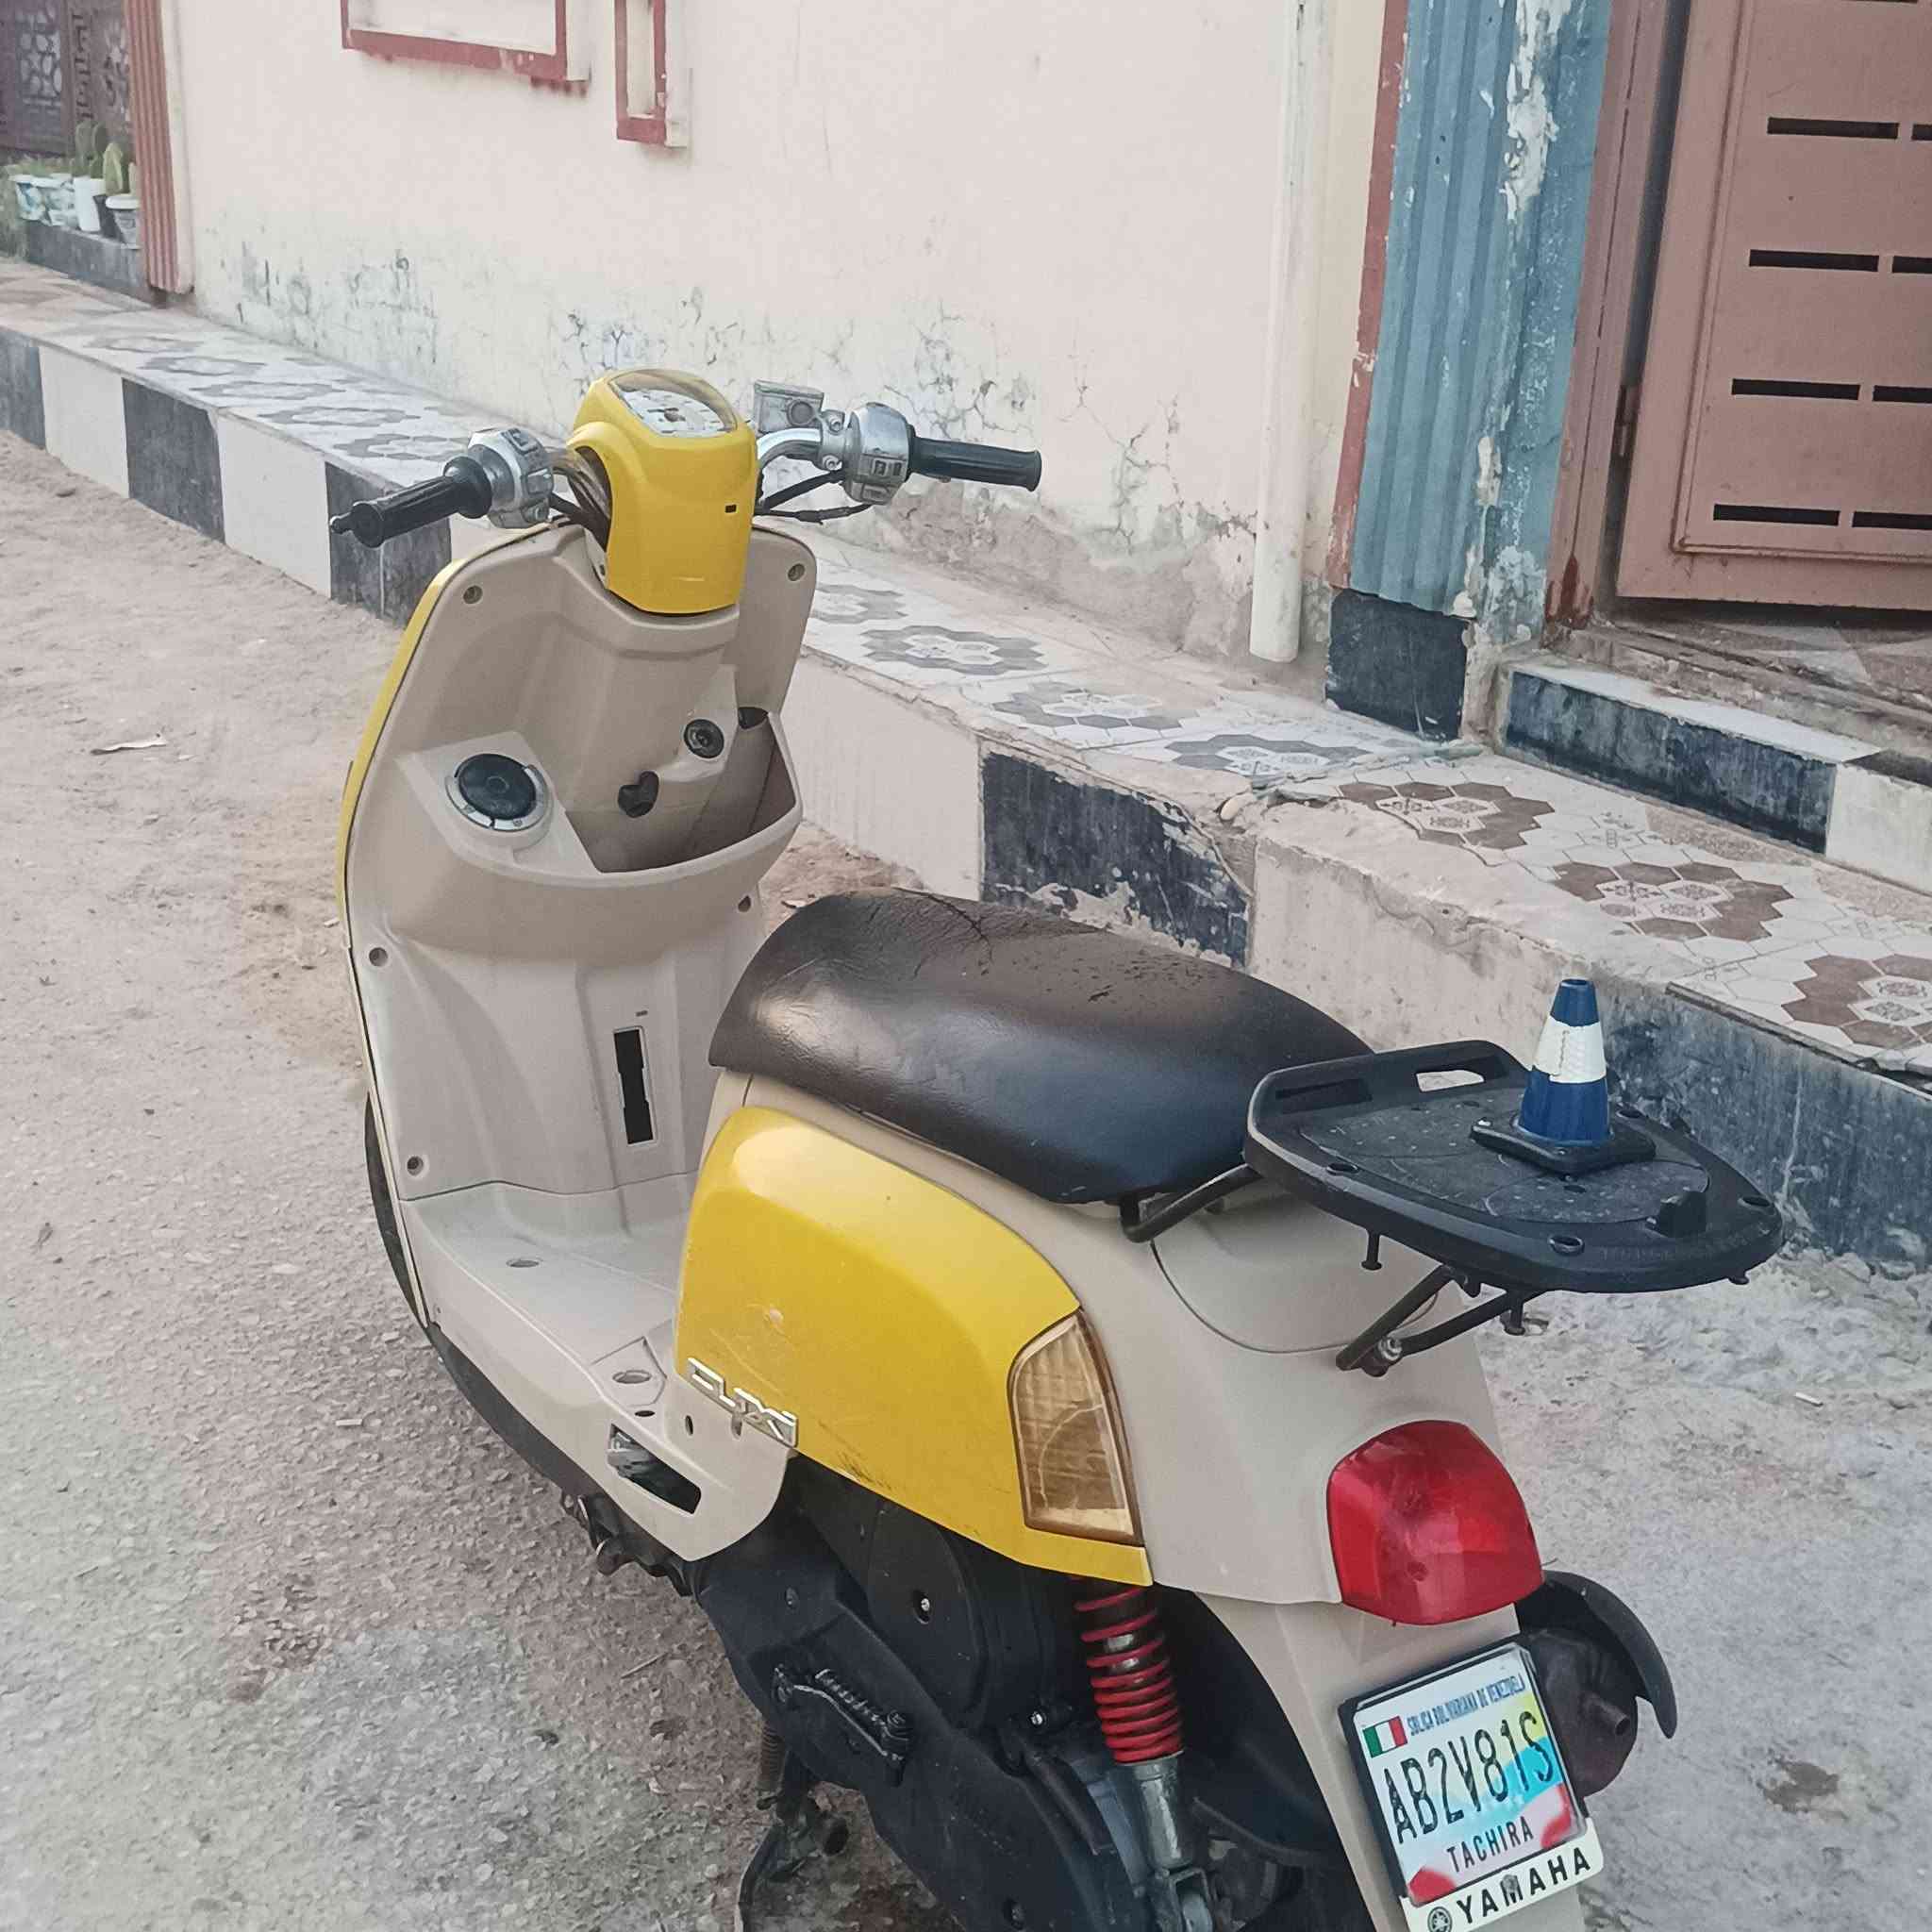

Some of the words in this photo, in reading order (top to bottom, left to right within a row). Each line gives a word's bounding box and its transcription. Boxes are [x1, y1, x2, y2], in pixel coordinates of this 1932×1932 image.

[1384, 1710, 1554, 1844] AB2V81S
[1446, 1816, 1534, 1873] TACHIRA
[1456, 1846, 1591, 1924] YAMAHA
